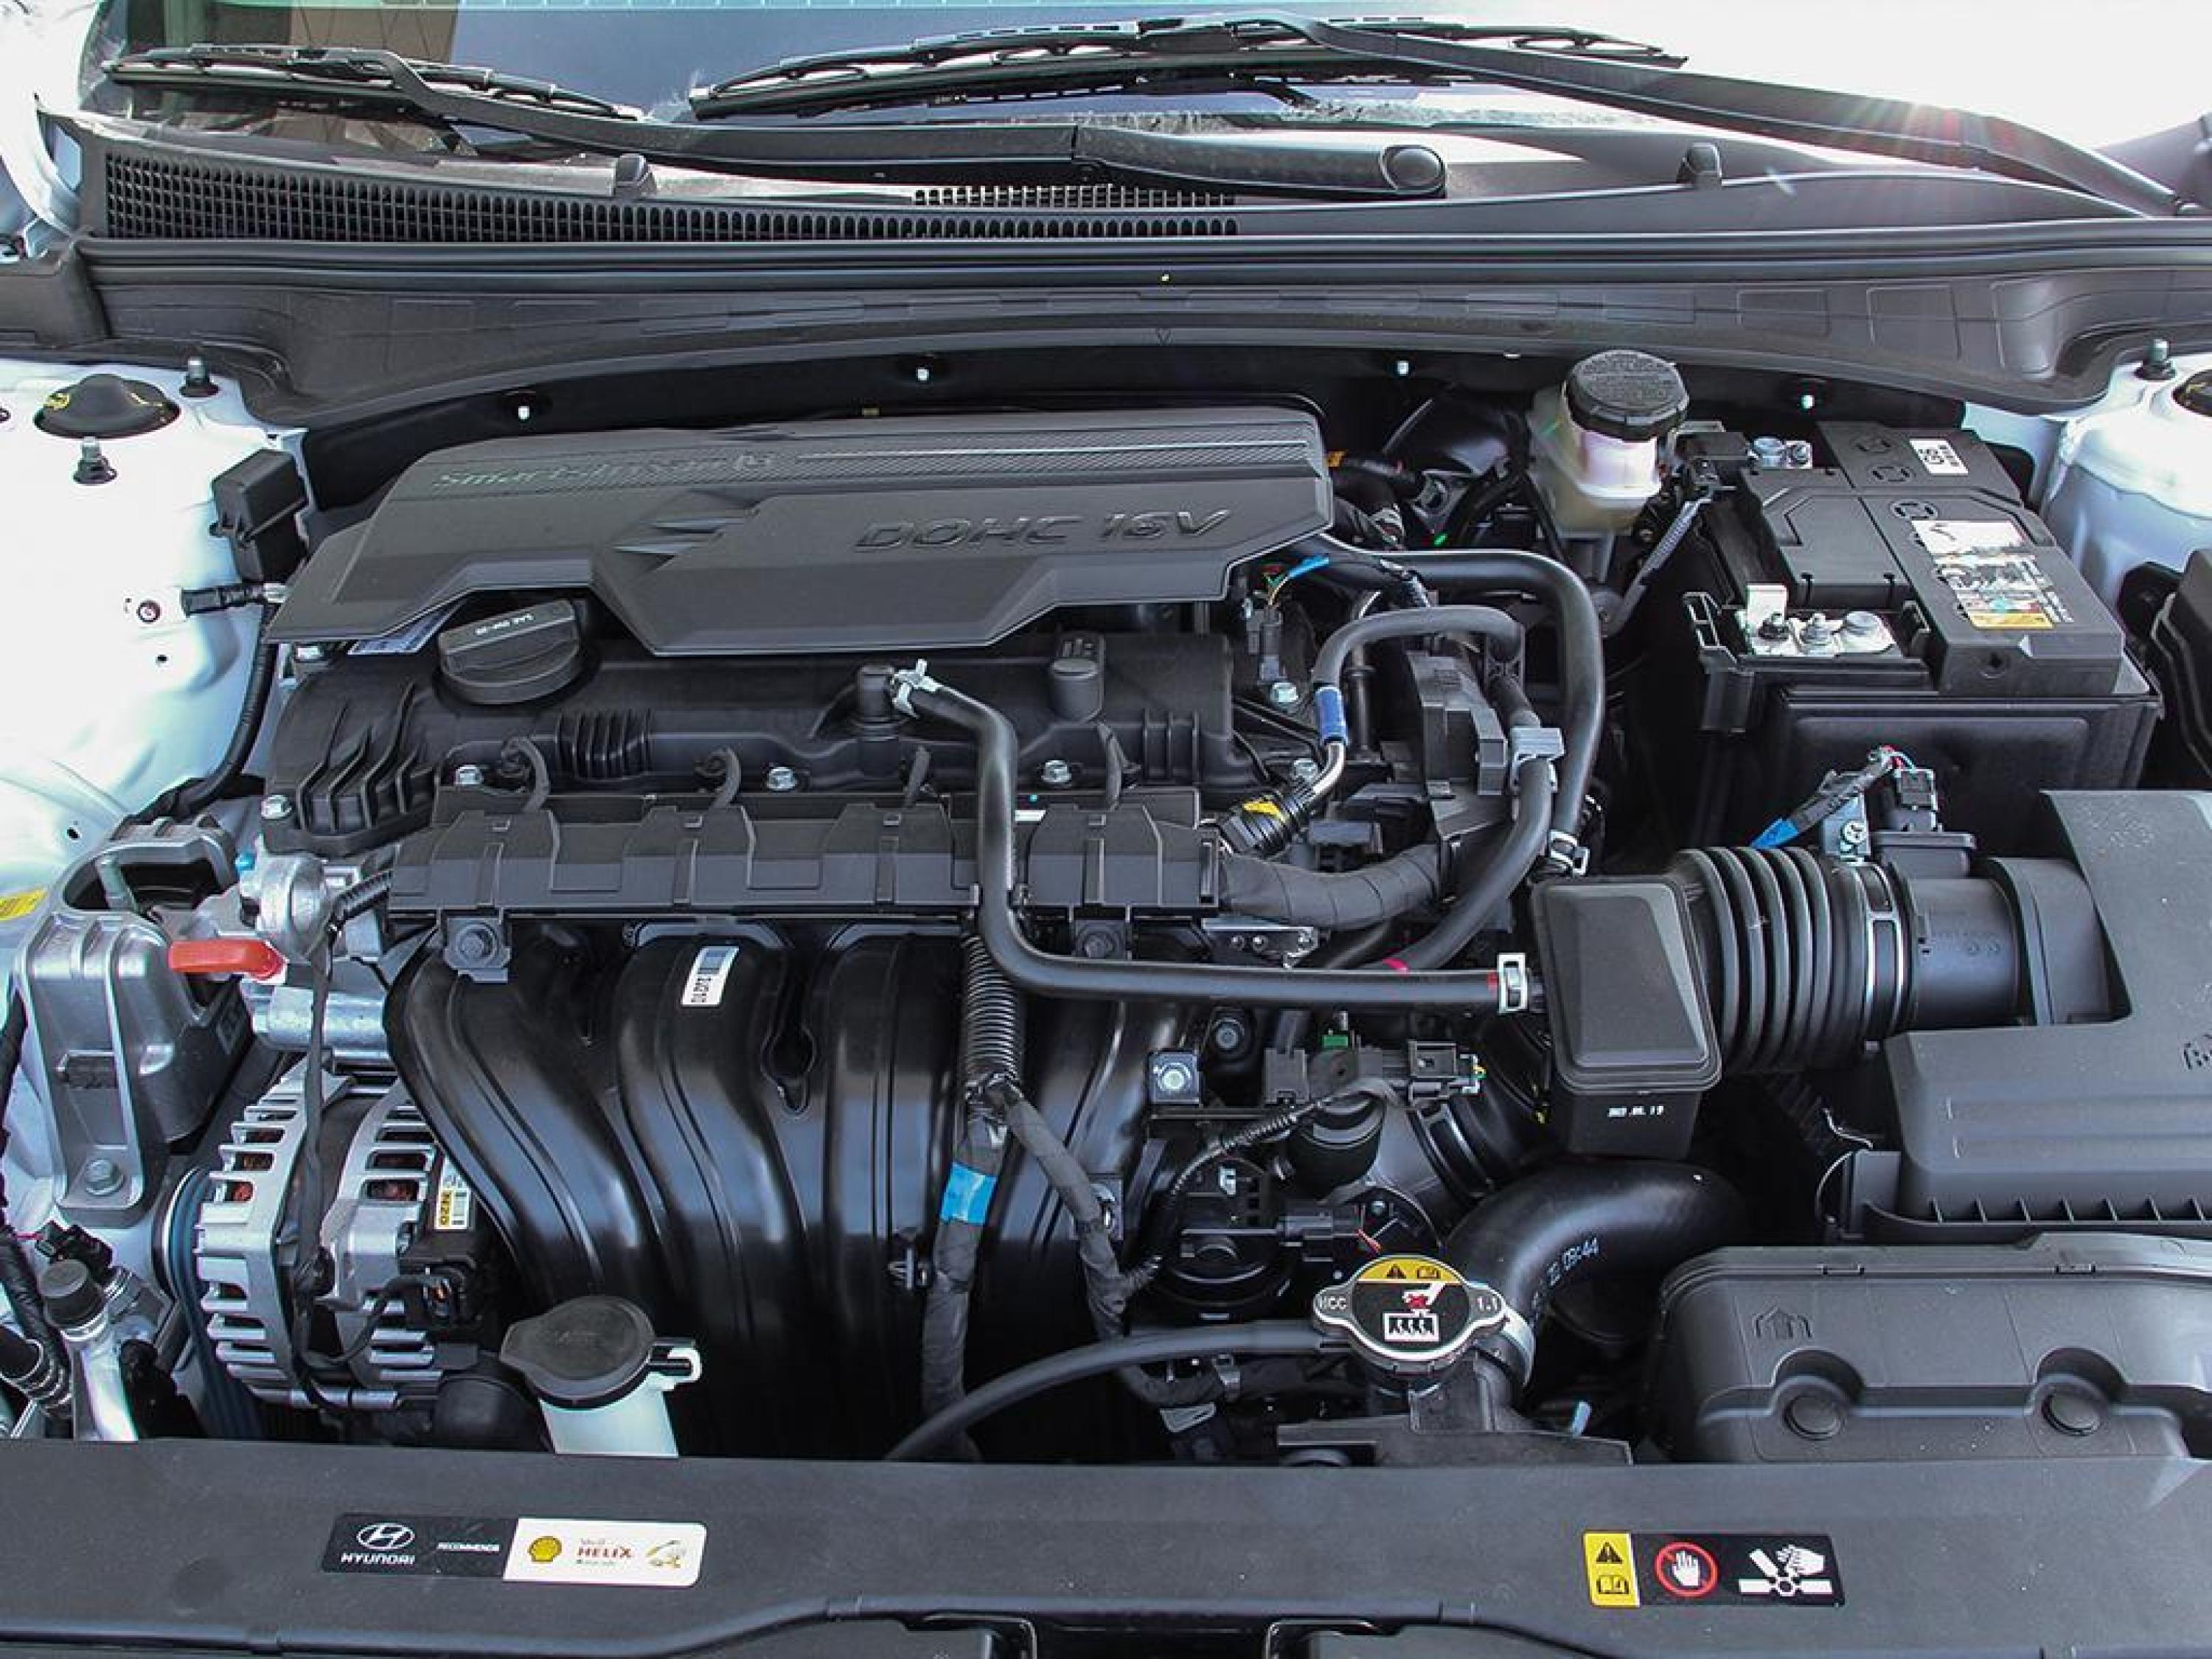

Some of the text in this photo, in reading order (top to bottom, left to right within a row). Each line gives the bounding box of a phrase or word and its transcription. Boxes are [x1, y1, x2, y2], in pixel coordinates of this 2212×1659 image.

[854, 509, 1230, 549] DOHC 16V
[341, 1551, 416, 1565] HYUNDAI
[577, 1545, 632, 1558] HELIX
